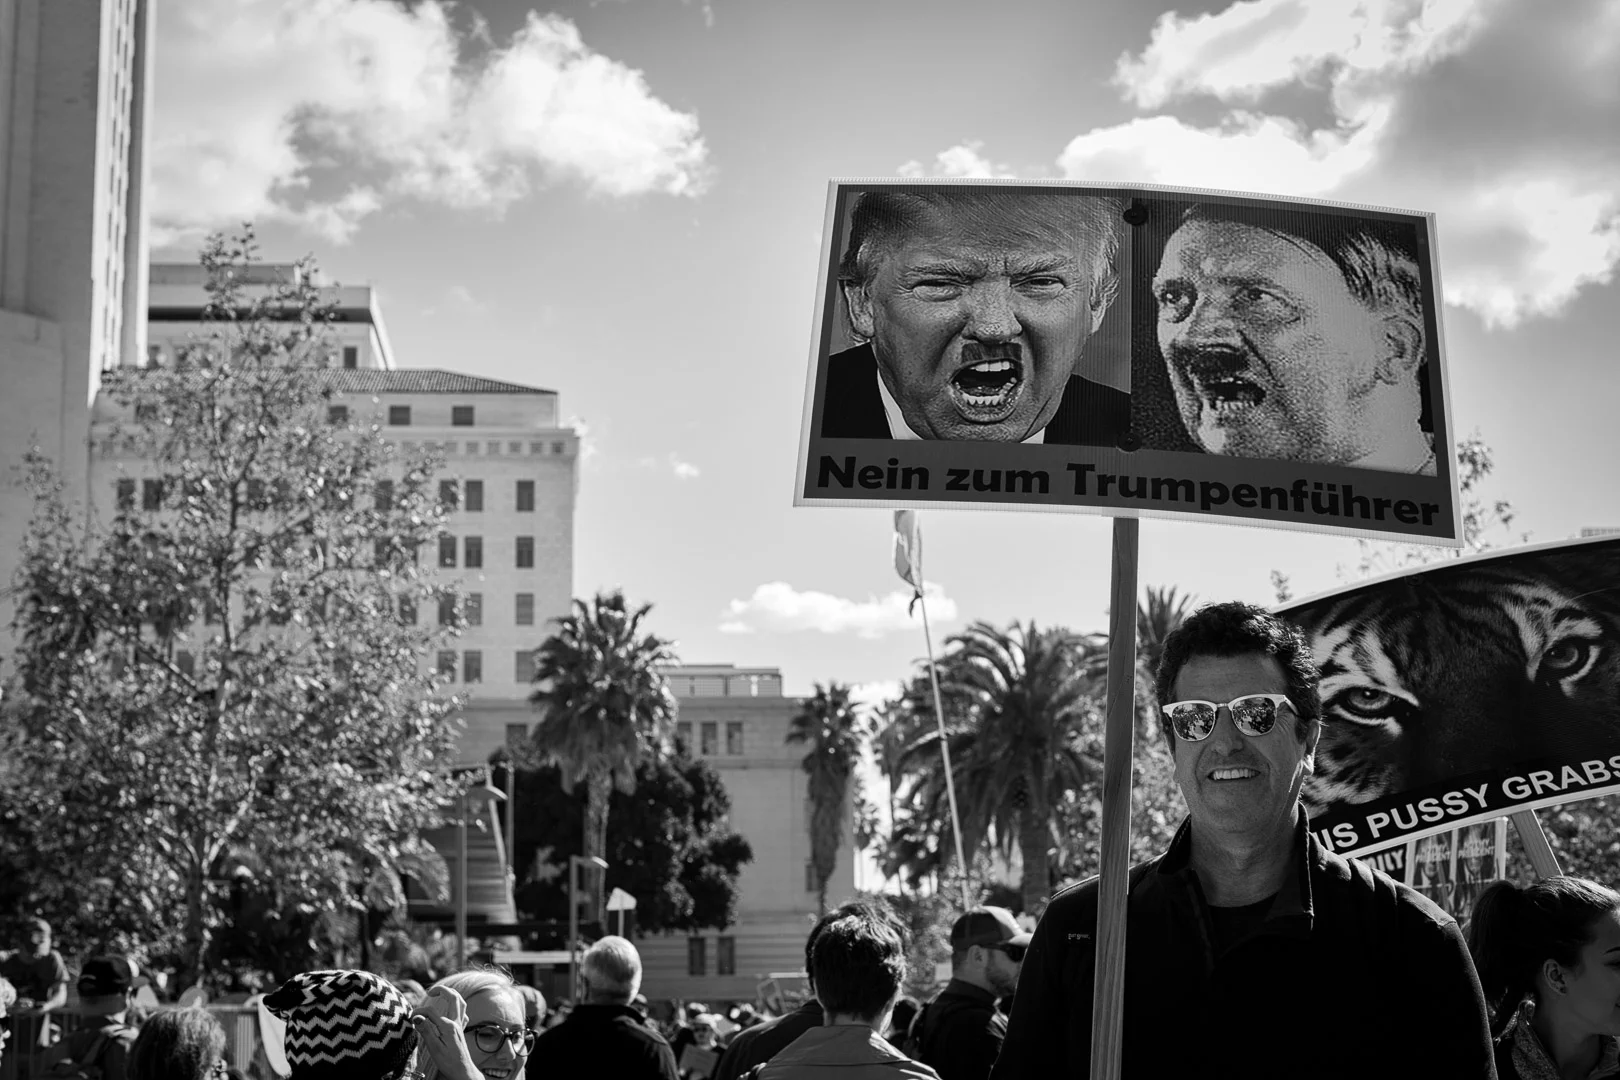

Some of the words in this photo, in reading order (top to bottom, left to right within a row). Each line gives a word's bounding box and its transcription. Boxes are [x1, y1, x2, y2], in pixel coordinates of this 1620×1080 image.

[817, 455, 930, 490] Nein
[945, 467, 1050, 494] zum
[1066, 462, 1440, 526] Trumpenführer
[1365, 783, 1490, 839] PUSSY
